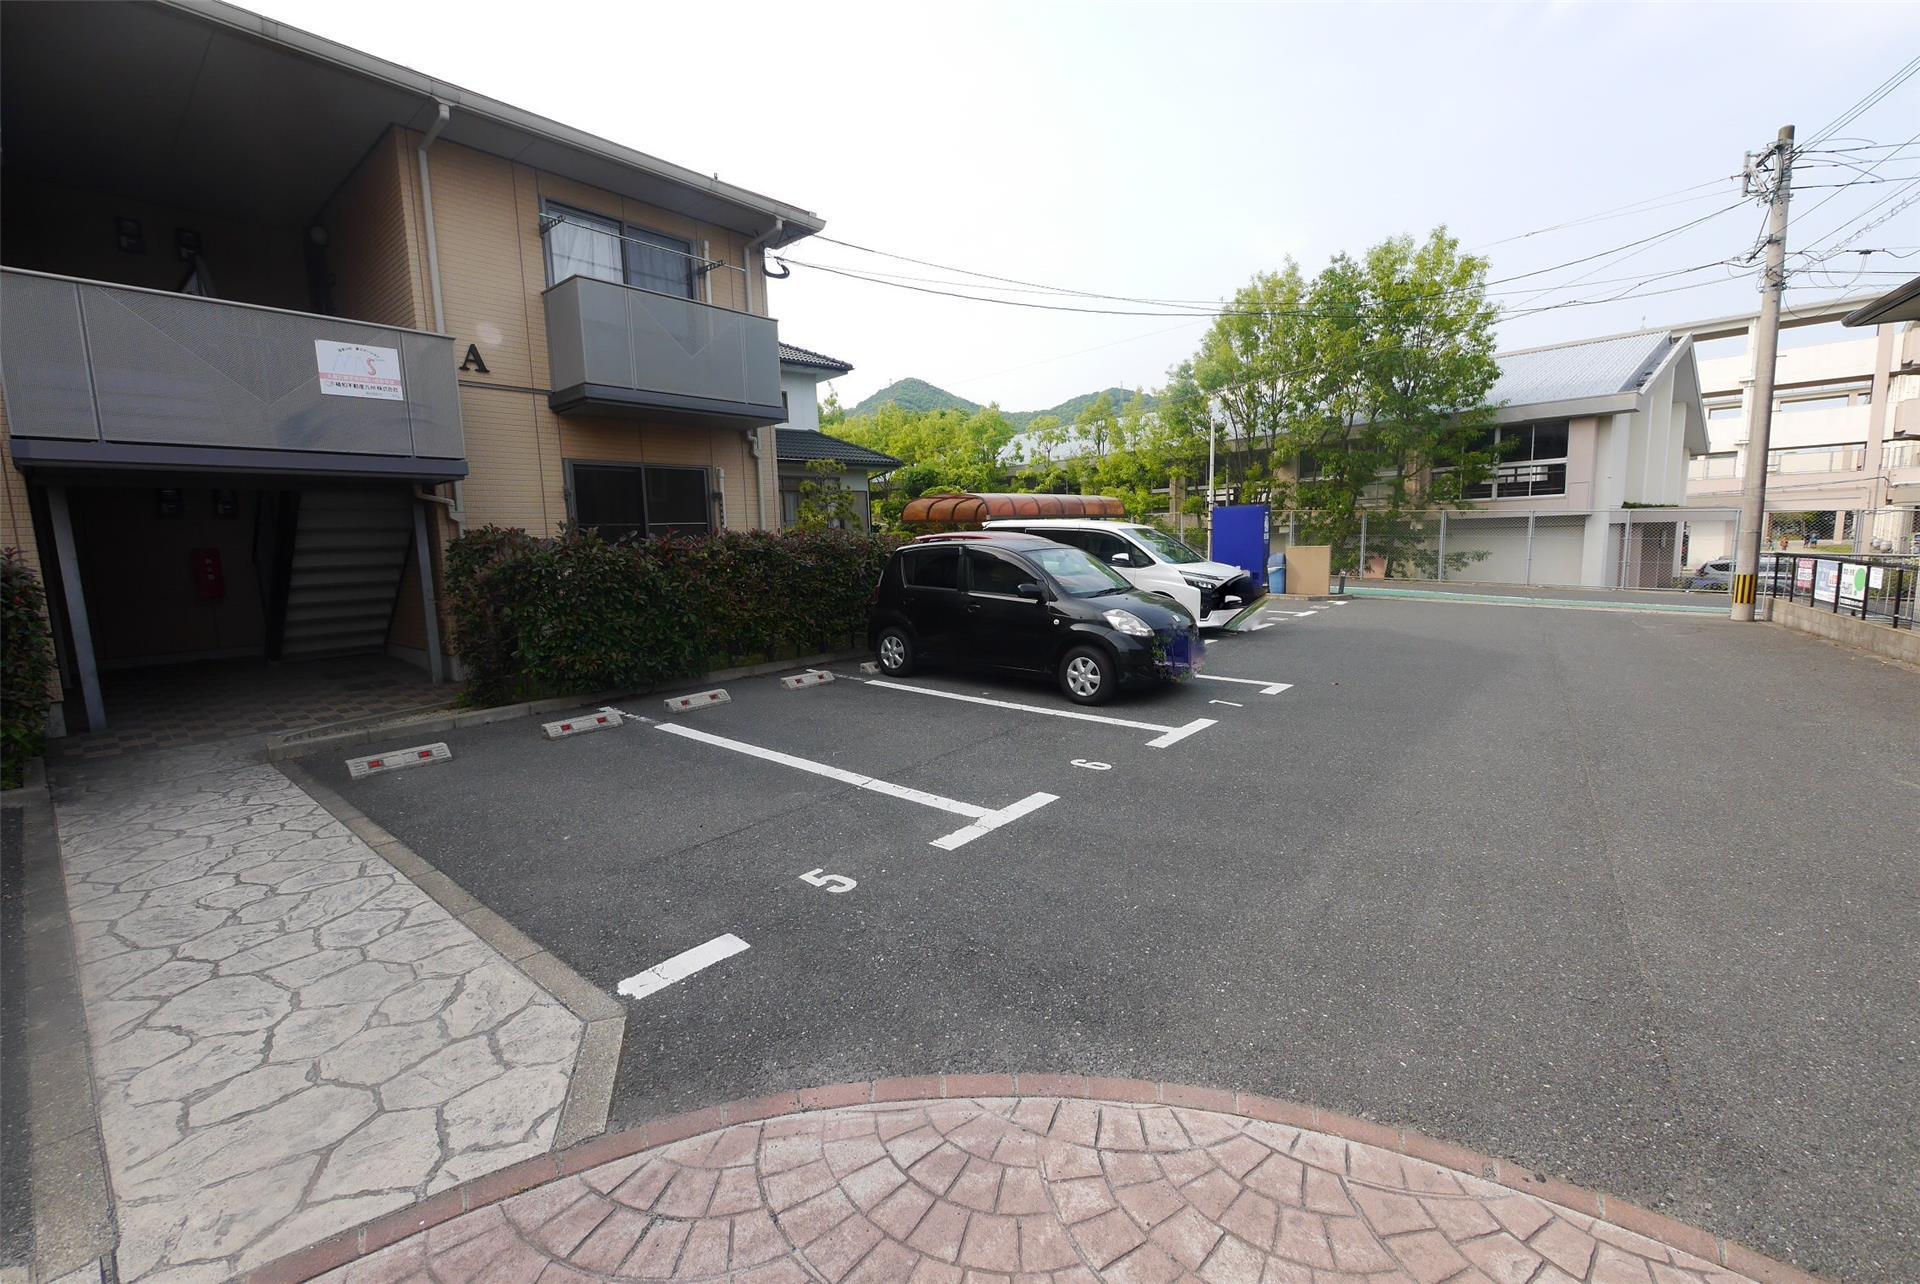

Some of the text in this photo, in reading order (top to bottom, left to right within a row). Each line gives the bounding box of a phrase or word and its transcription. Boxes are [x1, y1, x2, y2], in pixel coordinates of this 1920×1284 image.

[458, 343, 490, 373] A
[1070, 758, 1112, 770] 6
[798, 867, 858, 893] 5
